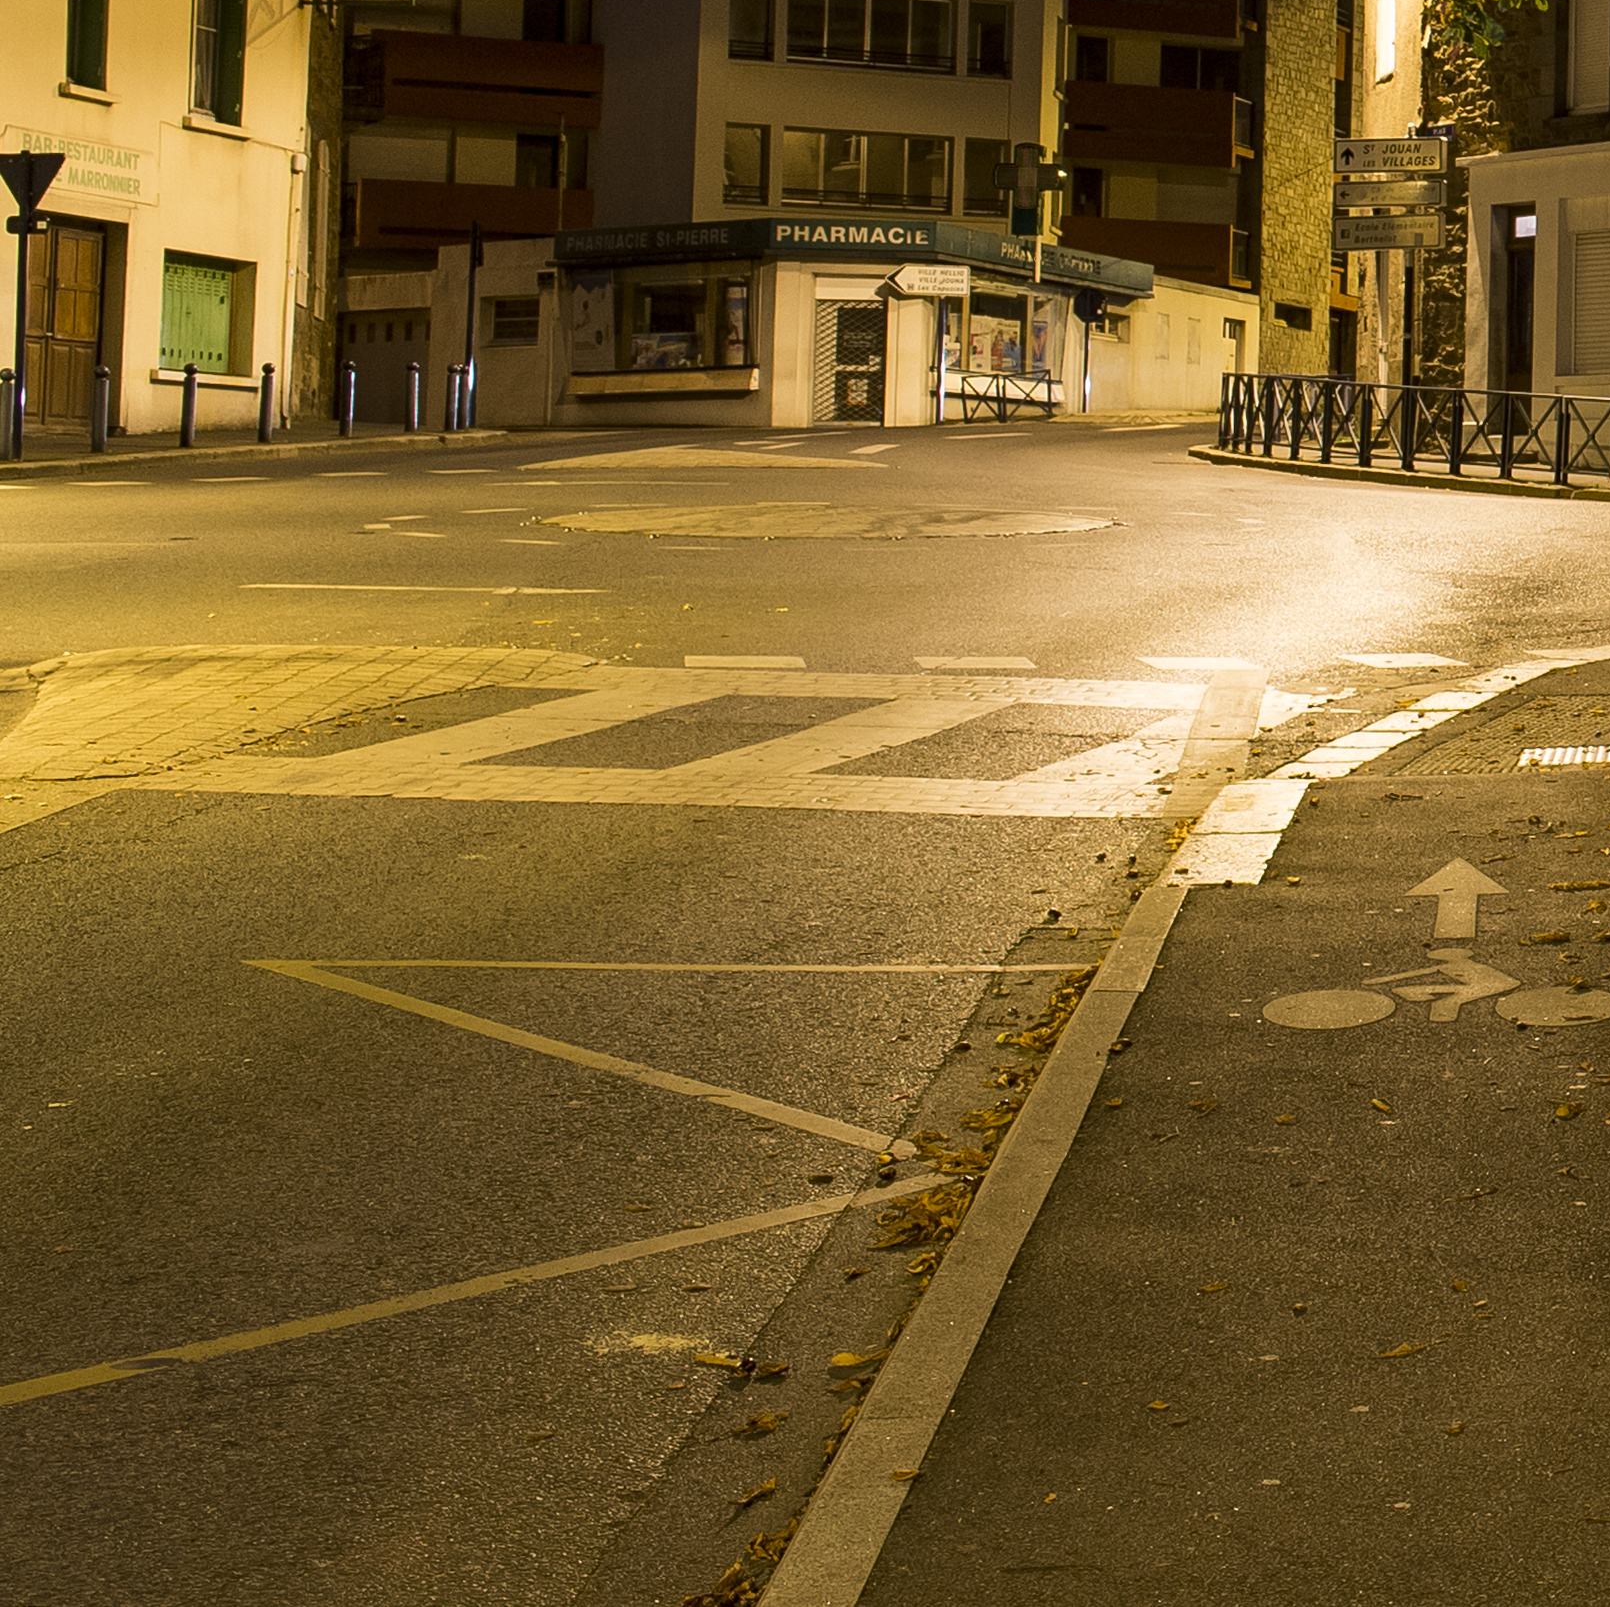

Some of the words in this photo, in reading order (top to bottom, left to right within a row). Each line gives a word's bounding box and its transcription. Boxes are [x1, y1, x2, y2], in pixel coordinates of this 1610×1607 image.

[1381, 143, 1422, 154] JOUAN
[1382, 155, 1437, 167] VILLAGES
[67, 166, 141, 196] MARRONNIER
[566, 232, 648, 252] PHARMACIE
[776, 225, 930, 245] PHARMACIE
